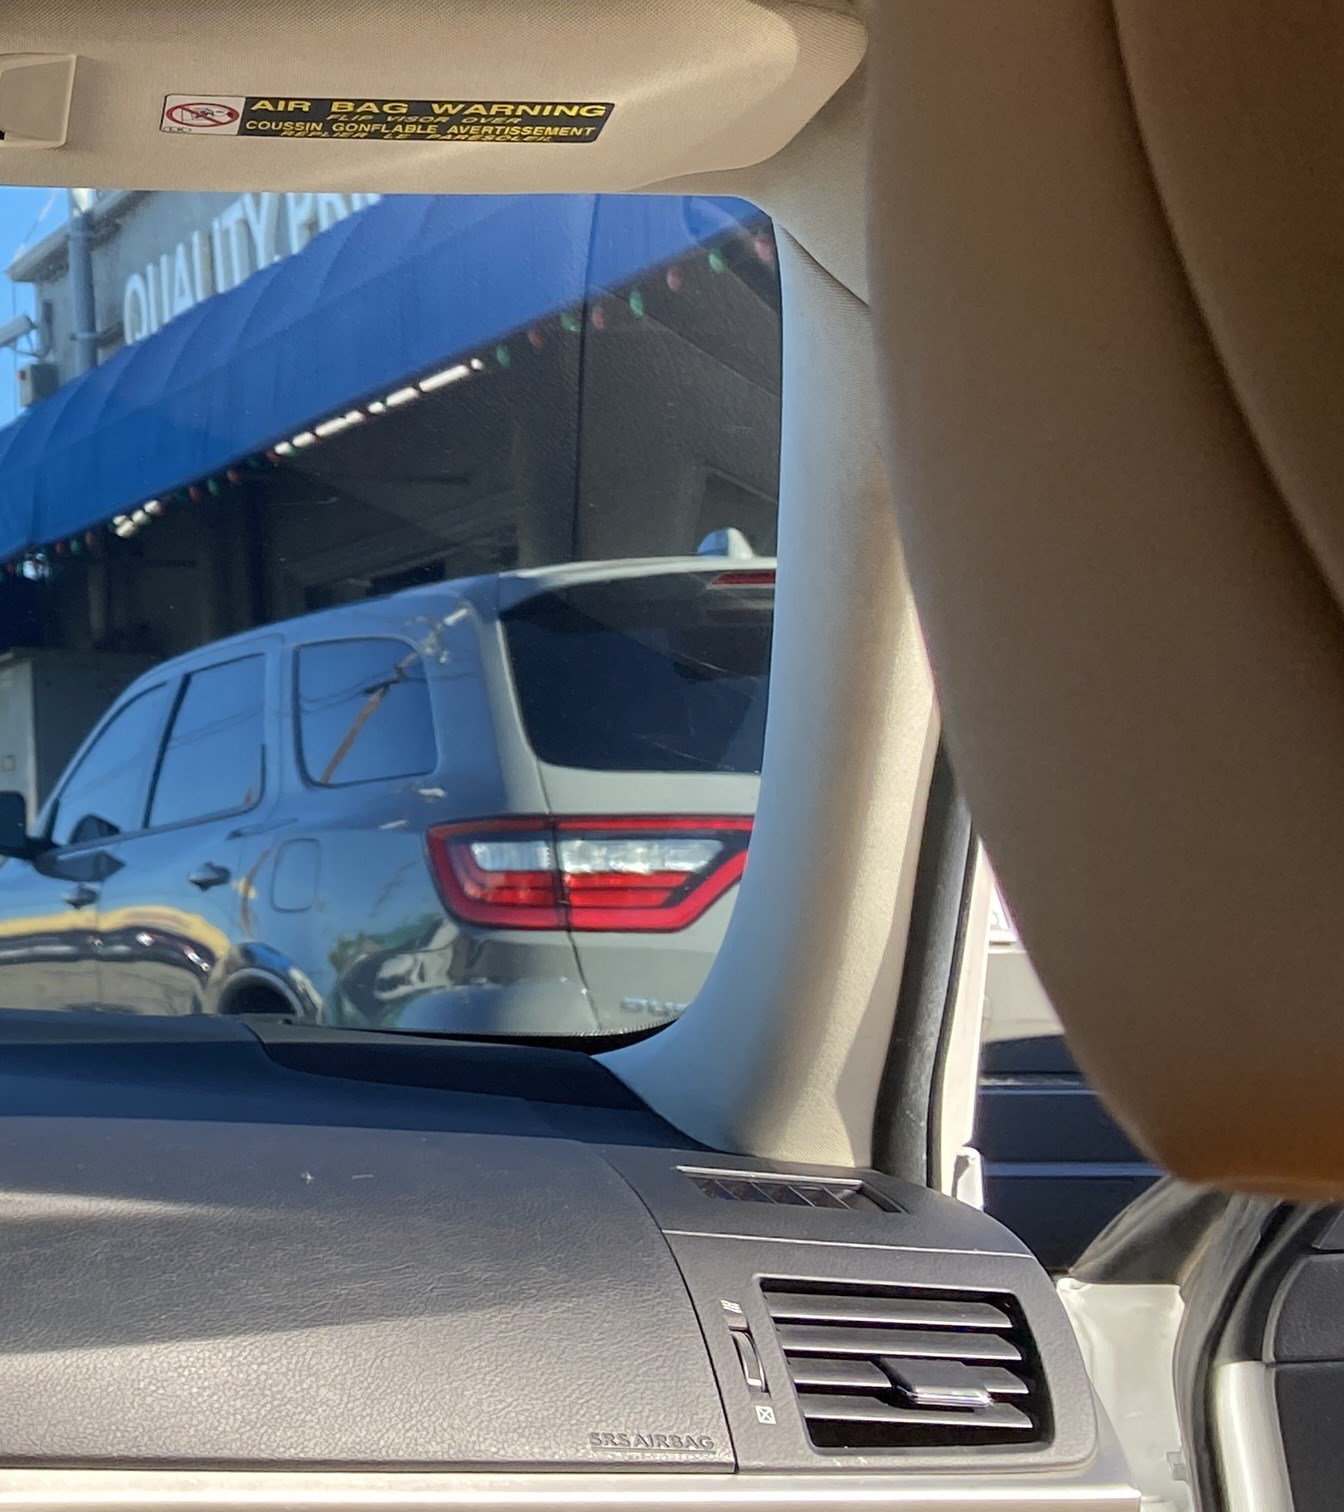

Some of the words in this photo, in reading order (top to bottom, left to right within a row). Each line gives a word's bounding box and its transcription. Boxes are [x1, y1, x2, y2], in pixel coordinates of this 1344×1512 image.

[250, 99, 312, 113] AIR
[329, 100, 409, 114] BAG
[430, 102, 606, 118] WARNING
[325, 113, 375, 122] FLIP
[385, 115, 451, 124] VISOR
[461, 117, 523, 125] OVER
[245, 120, 323, 132] COUSSIN
[331, 123, 439, 135] GONFLABLE
[446, 125, 597, 137] AVERTISSEMENT
[588, 1431, 631, 1447] SRS
[634, 1433, 715, 1450] AIRBAG
